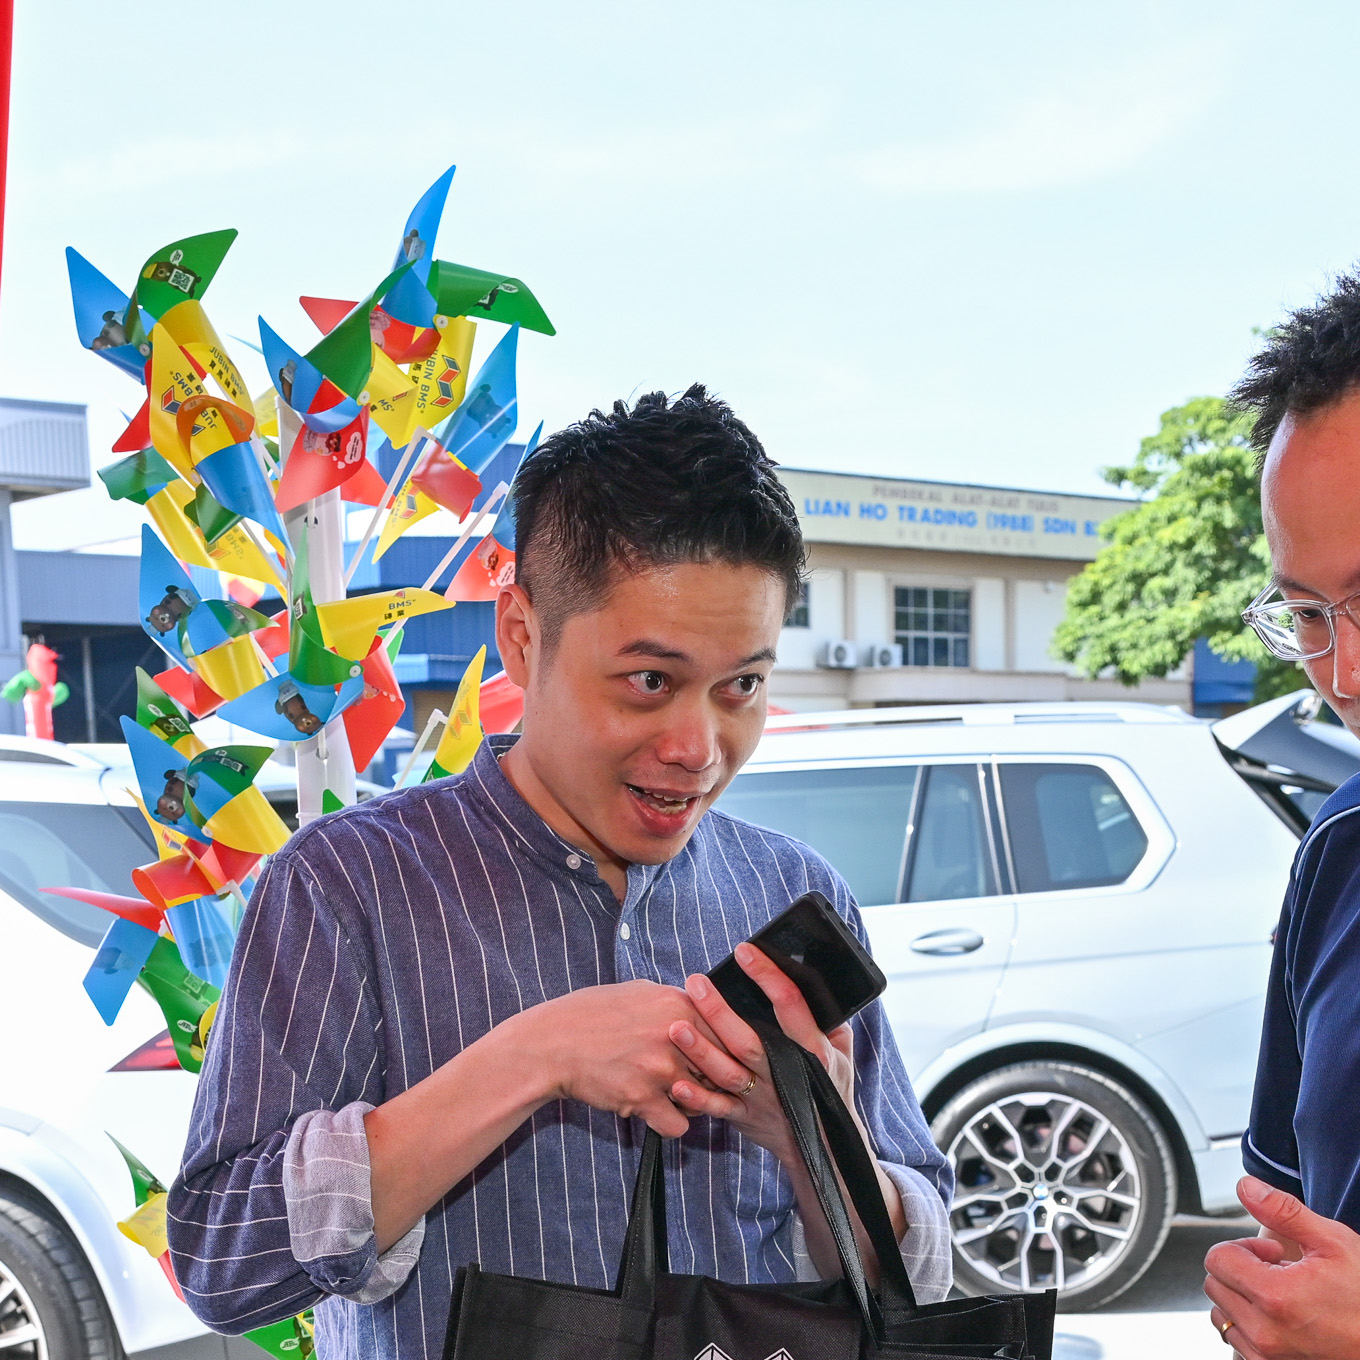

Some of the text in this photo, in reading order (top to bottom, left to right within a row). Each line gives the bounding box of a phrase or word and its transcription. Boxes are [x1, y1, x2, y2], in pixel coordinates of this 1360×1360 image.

[804, 498, 851, 518] LIAN
[859, 503, 888, 521] HO
[898, 505, 979, 529] TRADING
